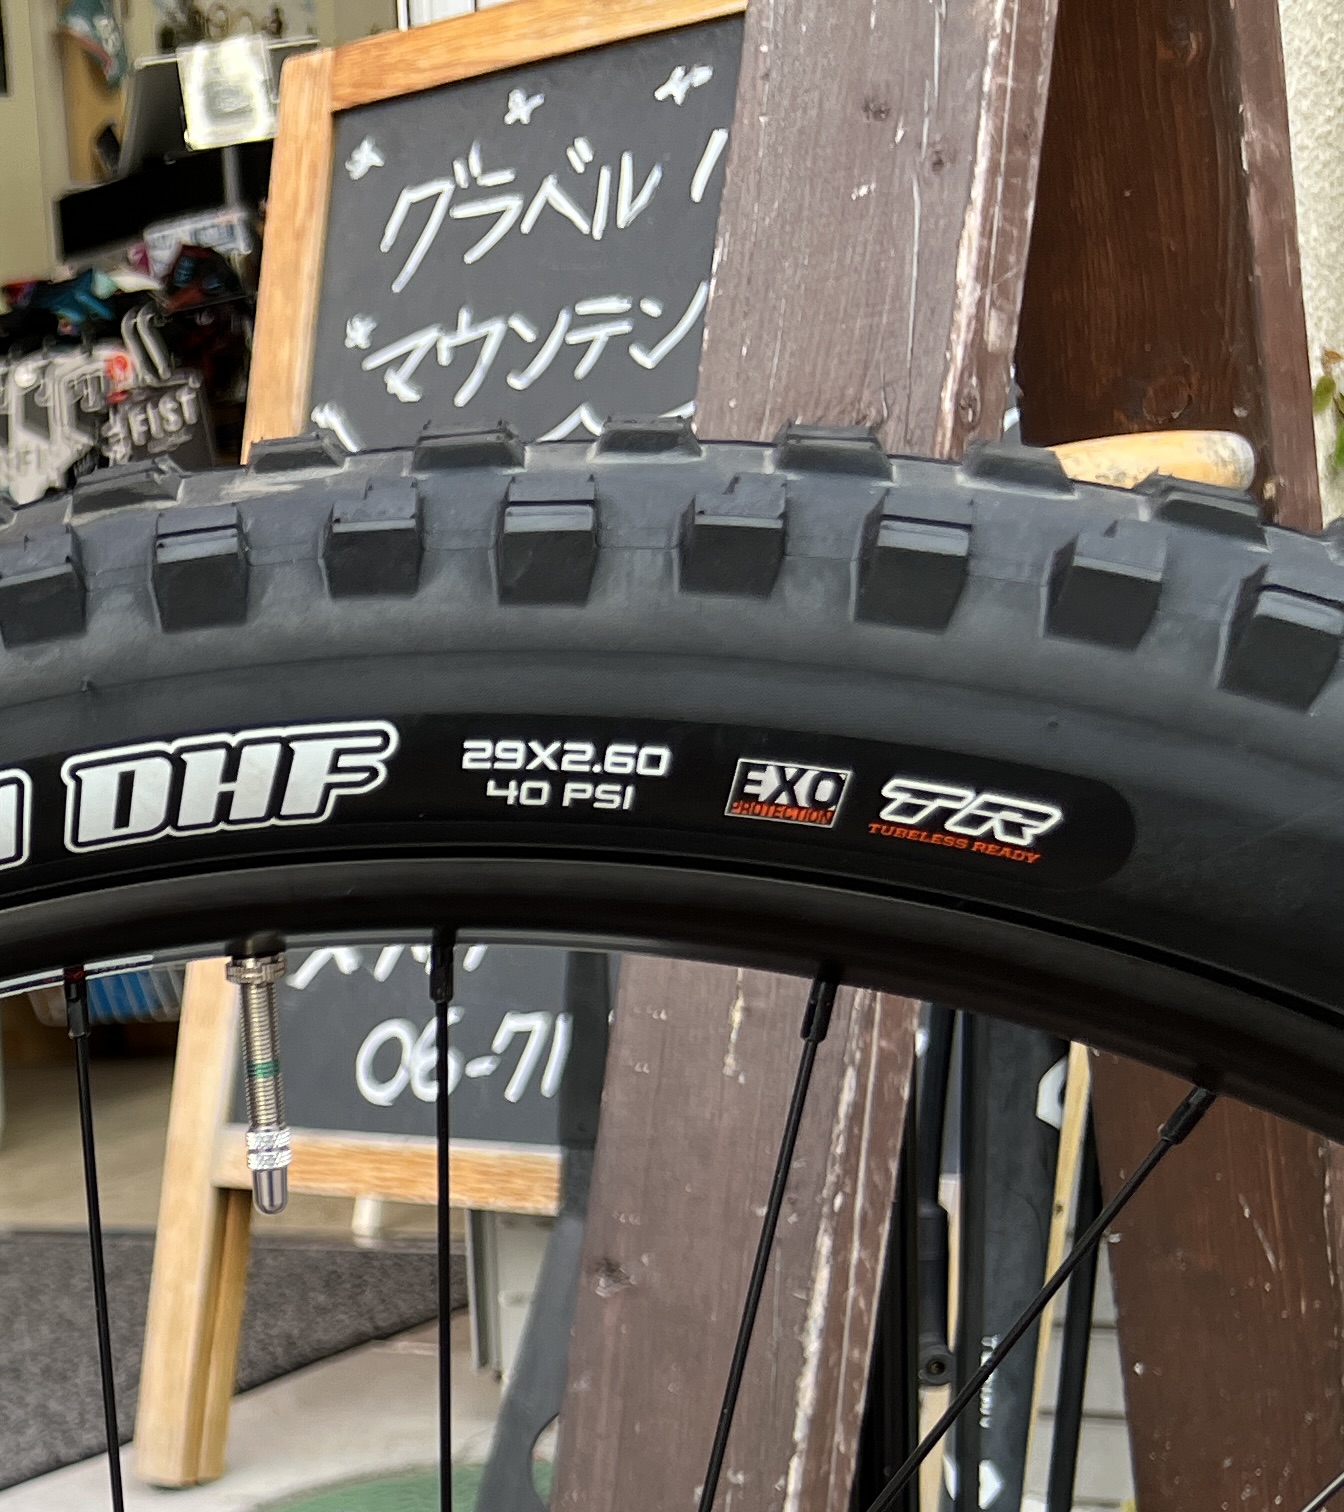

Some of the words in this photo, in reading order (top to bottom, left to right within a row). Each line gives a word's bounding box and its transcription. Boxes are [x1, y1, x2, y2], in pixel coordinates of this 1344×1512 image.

[378, 127, 730, 294] グラベル
[127, 385, 199, 447] FIST
[461, 736, 671, 777] 29X2.60
[61, 719, 400, 853] DHF
[485, 779, 553, 810] 40
[562, 781, 636, 811] PSI
[738, 761, 847, 811] EXO
[880, 777, 1063, 847] TR
[867, 822, 969, 851] TUBELESS
[970, 840, 1042, 865] READY
